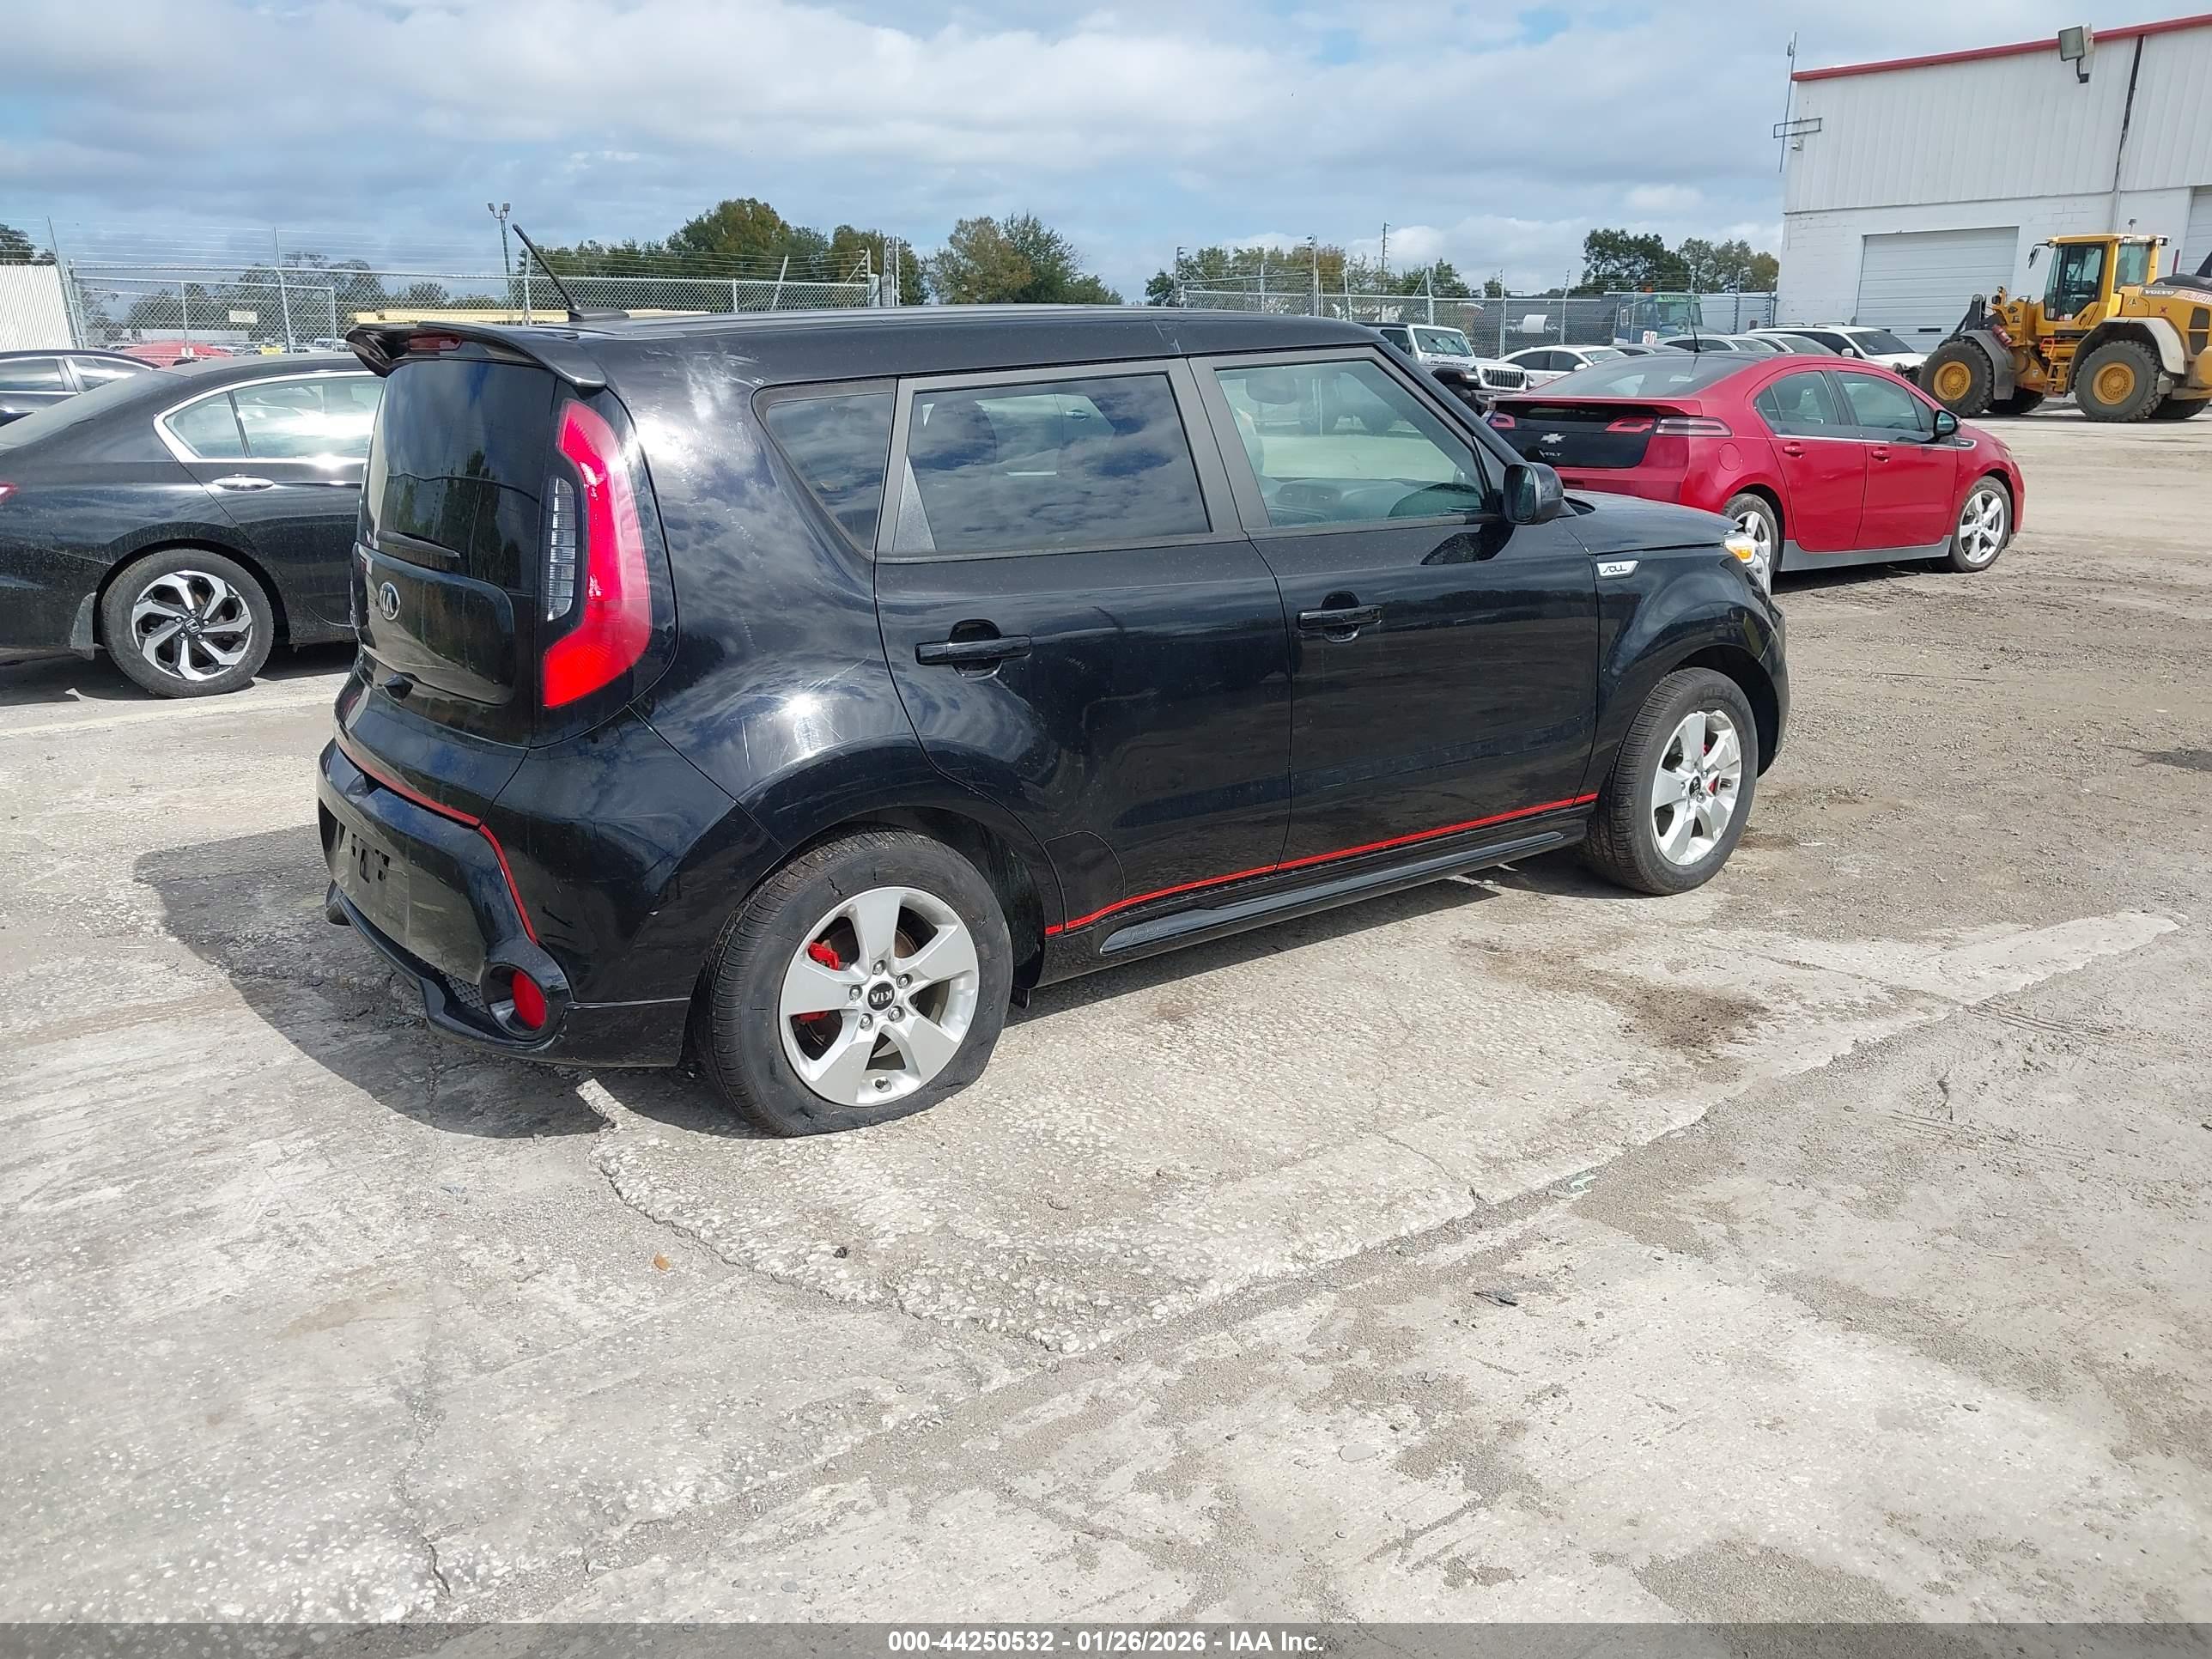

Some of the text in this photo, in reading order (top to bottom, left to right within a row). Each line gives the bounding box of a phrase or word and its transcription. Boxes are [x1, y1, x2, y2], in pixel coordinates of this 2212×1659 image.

[1538, 449, 1562, 459] VOLT
[1602, 564, 1628, 574] SOUL
[870, 988, 894, 1003] KIA
